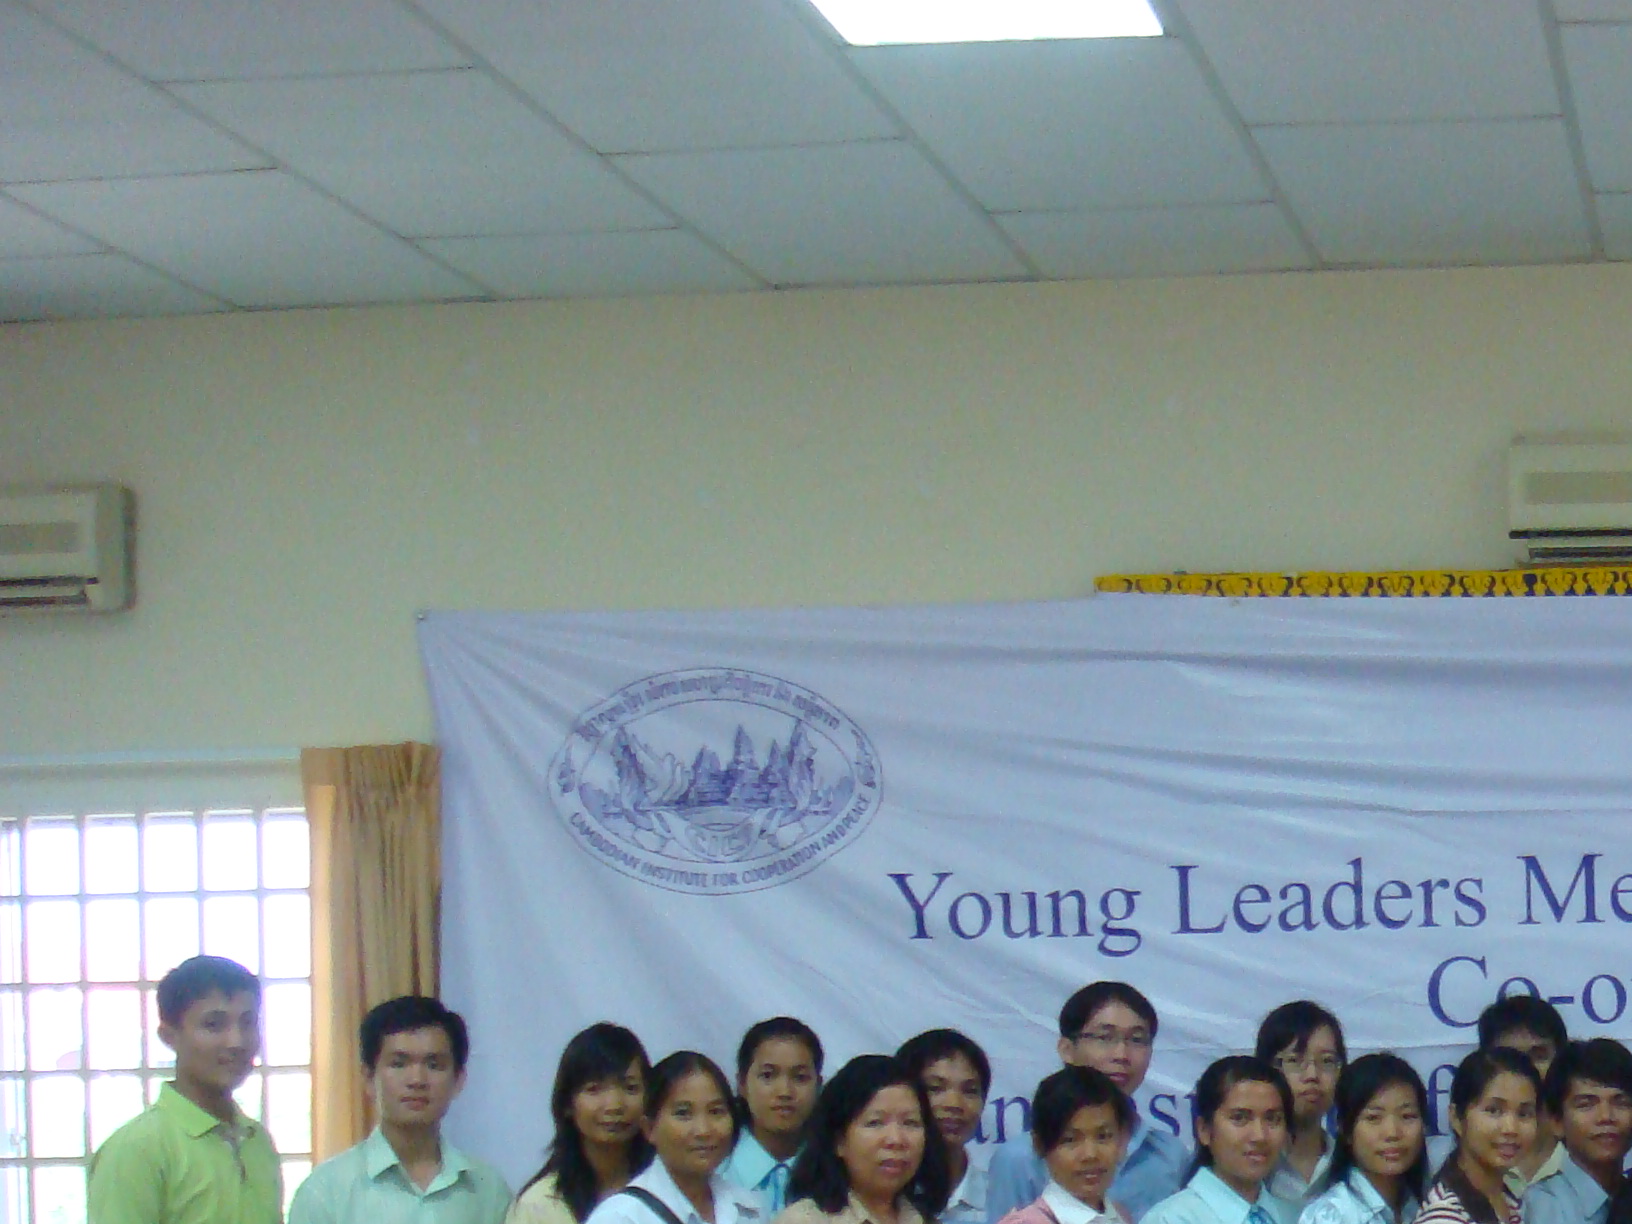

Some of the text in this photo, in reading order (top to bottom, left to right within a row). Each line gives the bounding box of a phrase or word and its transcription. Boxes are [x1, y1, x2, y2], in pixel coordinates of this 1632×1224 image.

[640, 861, 708, 887] INSTITUTE
[711, 870, 740, 886] FOR
[741, 840, 822, 884] COOPERATION
[887, 871, 1142, 958] Young
[1170, 857, 1488, 935] Leaders
